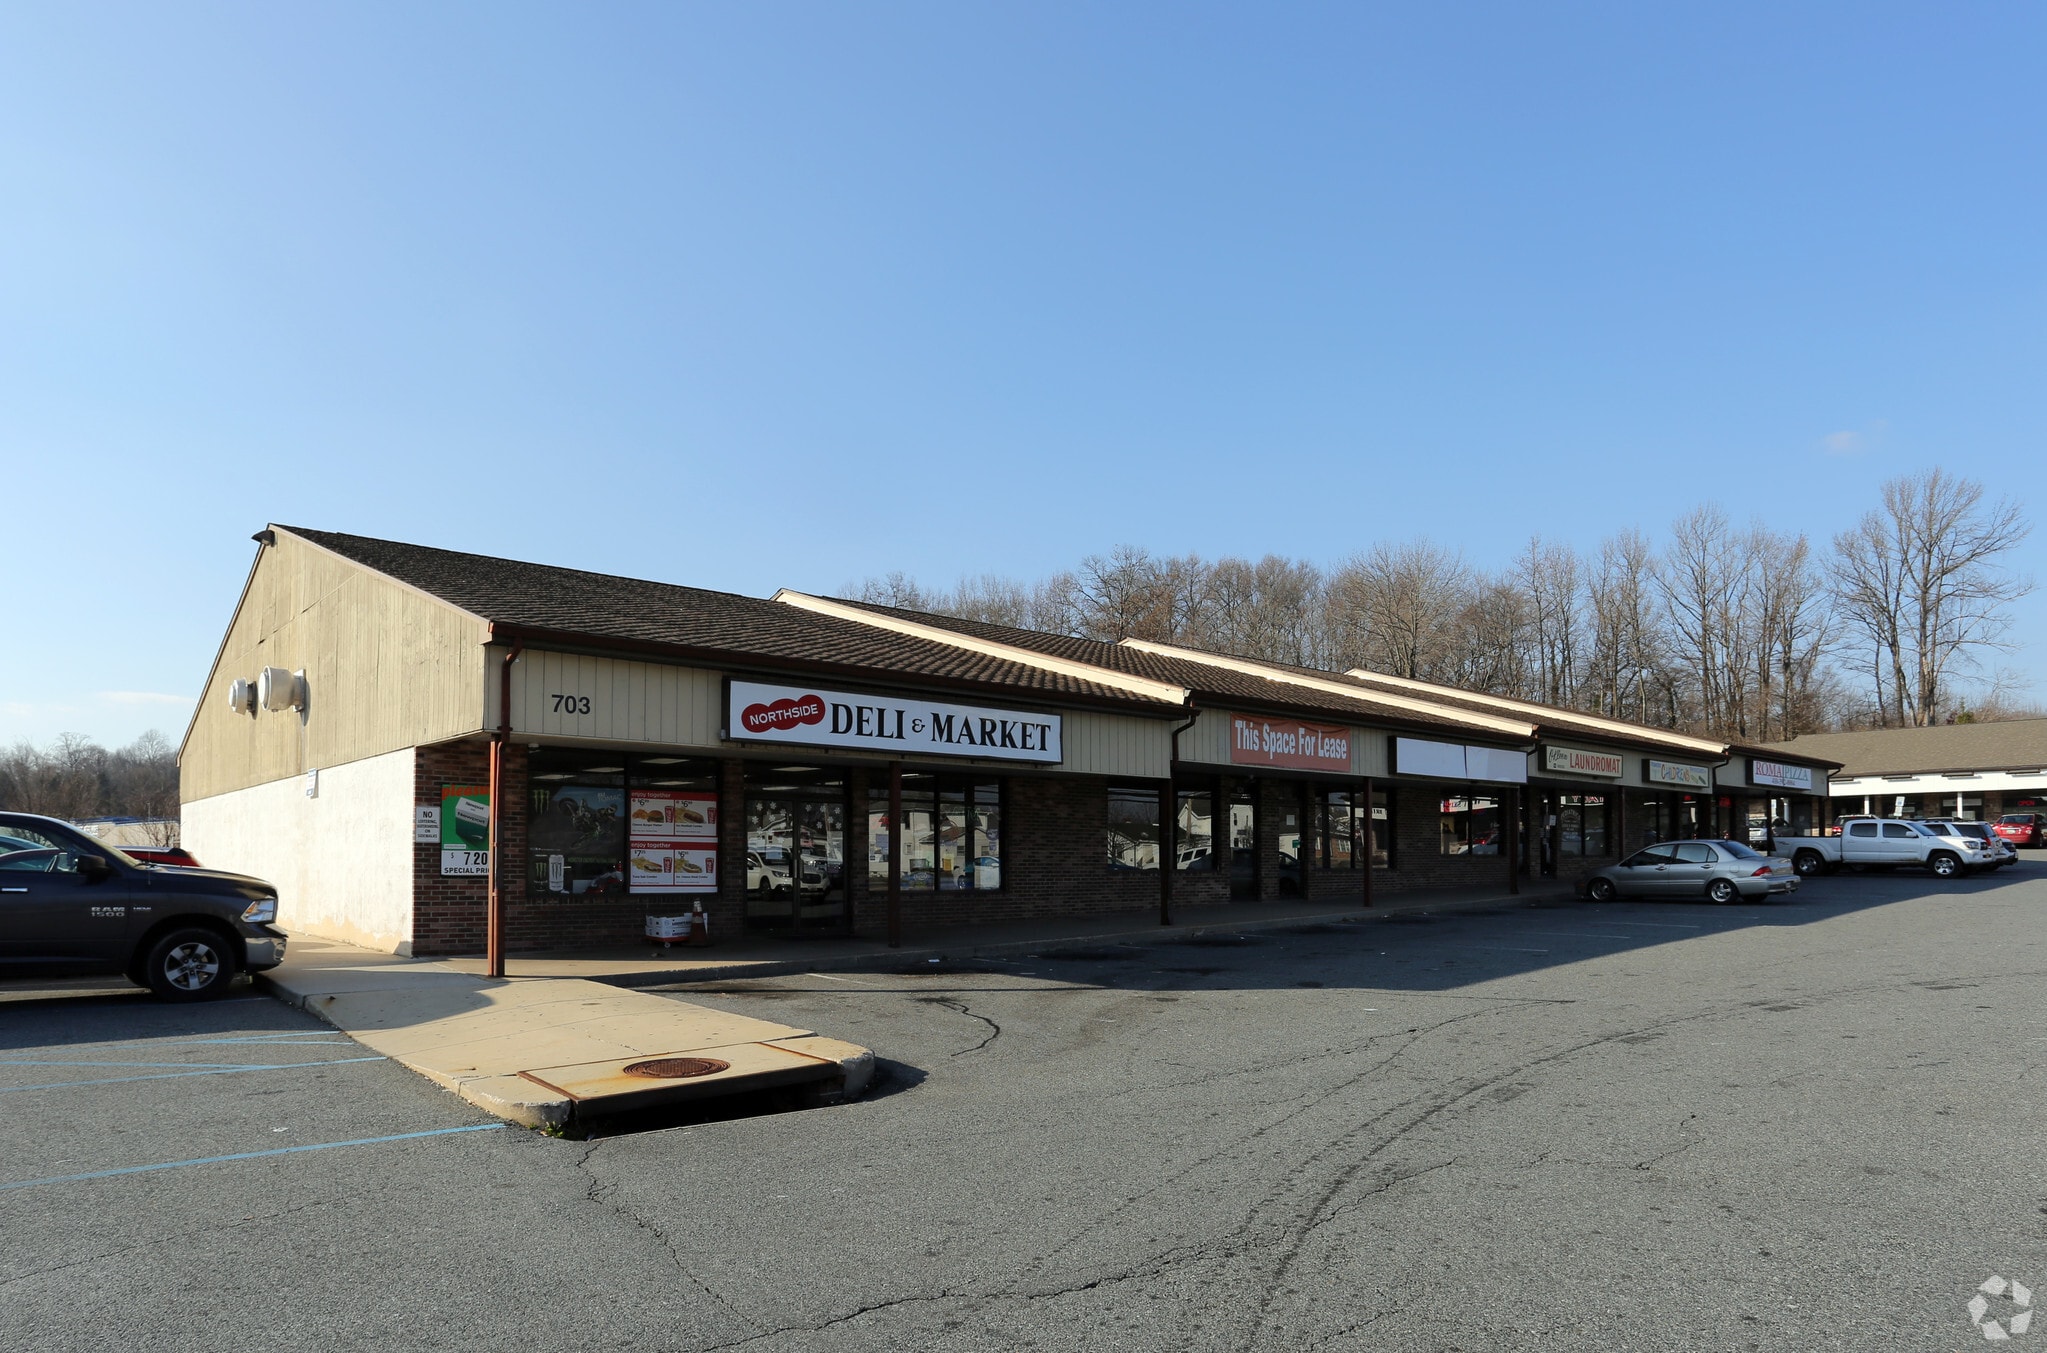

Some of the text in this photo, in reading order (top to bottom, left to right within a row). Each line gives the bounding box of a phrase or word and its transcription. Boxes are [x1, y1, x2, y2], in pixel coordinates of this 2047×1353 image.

[552, 694, 591, 715] 703
[749, 704, 819, 726] NORTHSIDE
[828, 702, 1051, 751] DELI & MARKET
[1235, 719, 1347, 760] This Space For Lease
[1569, 752, 1621, 774] LAUNDROMAT
[1755, 761, 1783, 778] ROMA
[1784, 766, 1809, 782] PIZZA
[422, 810, 433, 819] NO
